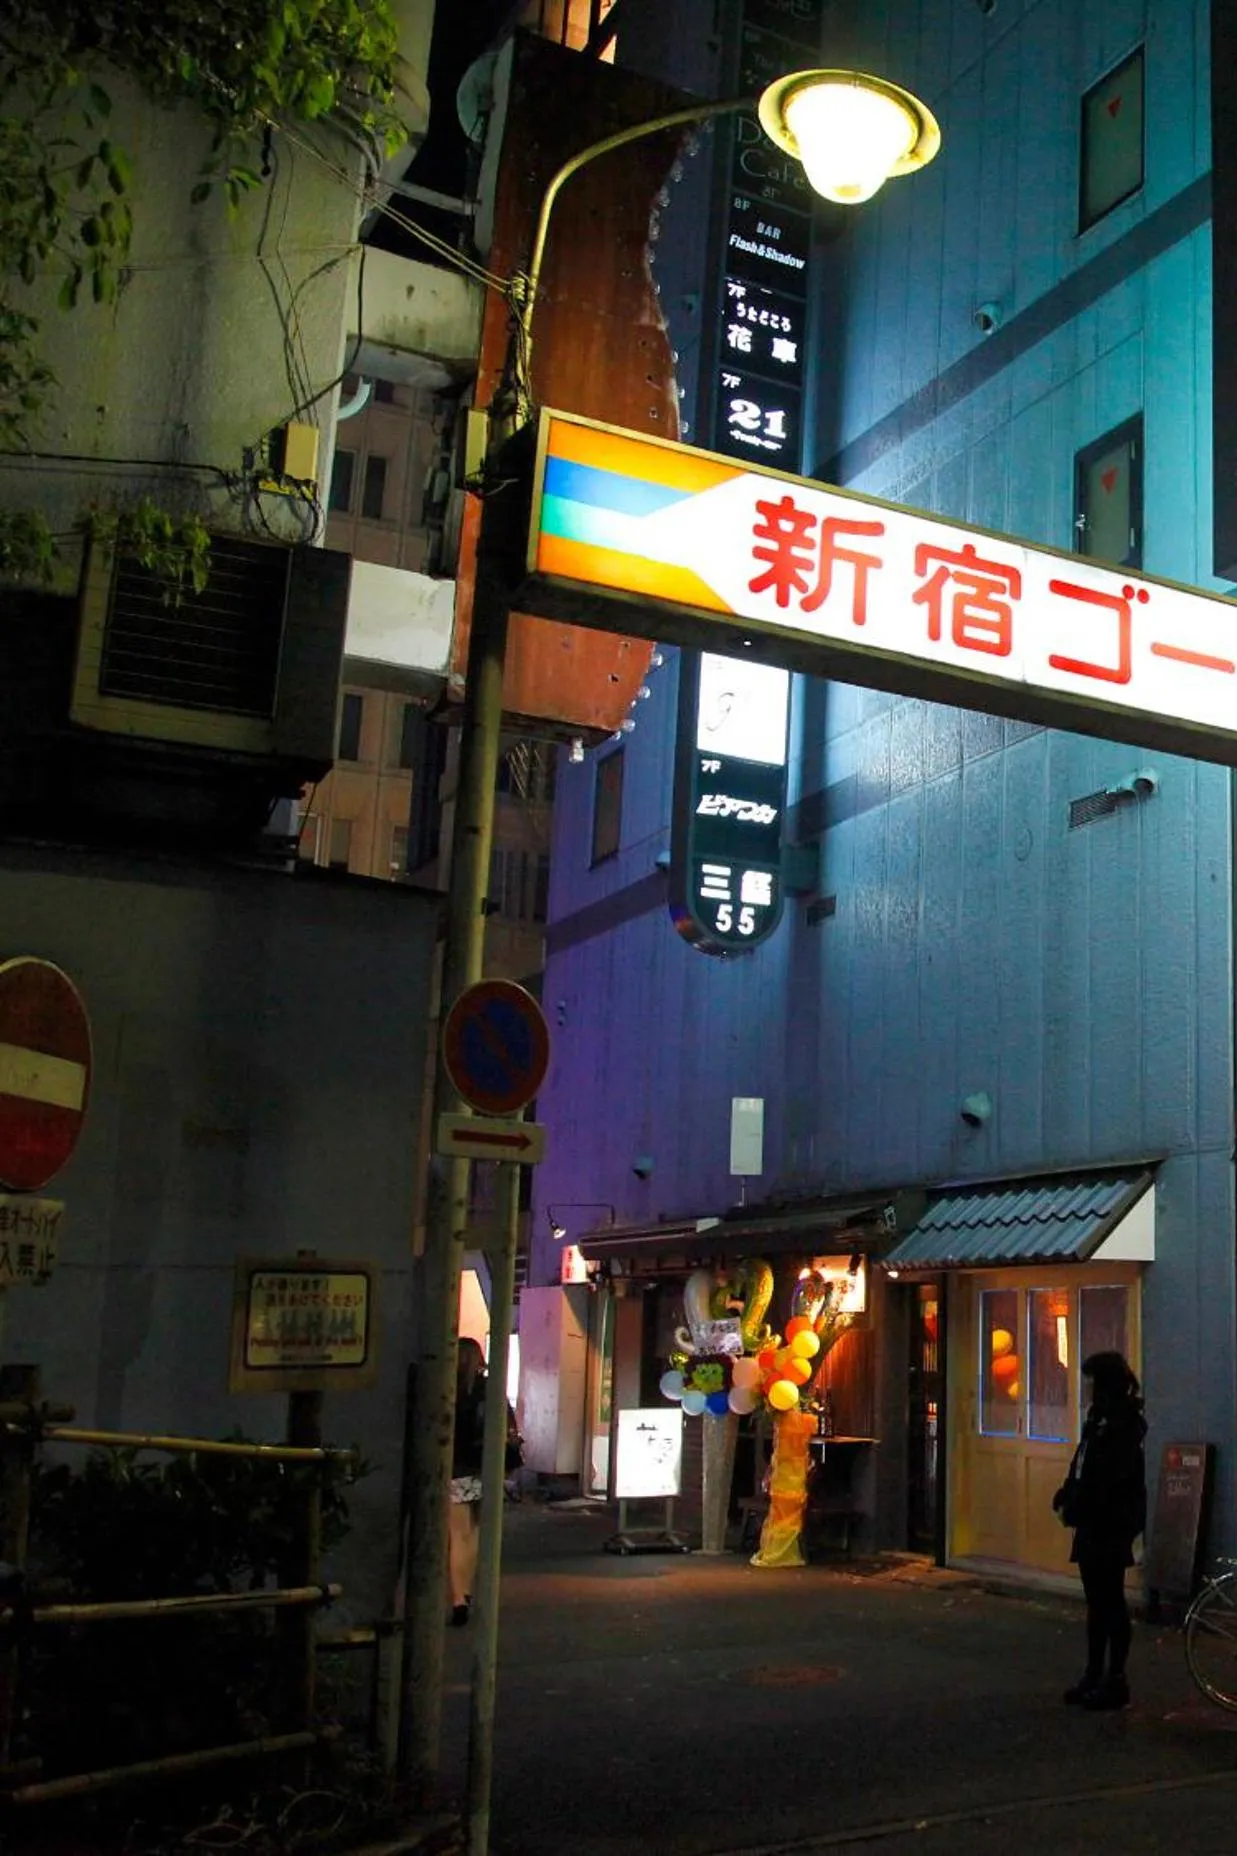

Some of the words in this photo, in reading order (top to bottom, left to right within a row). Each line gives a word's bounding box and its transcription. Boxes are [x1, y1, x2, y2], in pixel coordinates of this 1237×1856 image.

[756, 221, 781, 240] BAR
[729, 234, 805, 270] Flash&Shadow
[727, 283, 746, 298] 7F
[722, 372, 741, 388] 7F
[728, 398, 787, 439] 21
[702, 760, 721, 773] 7F
